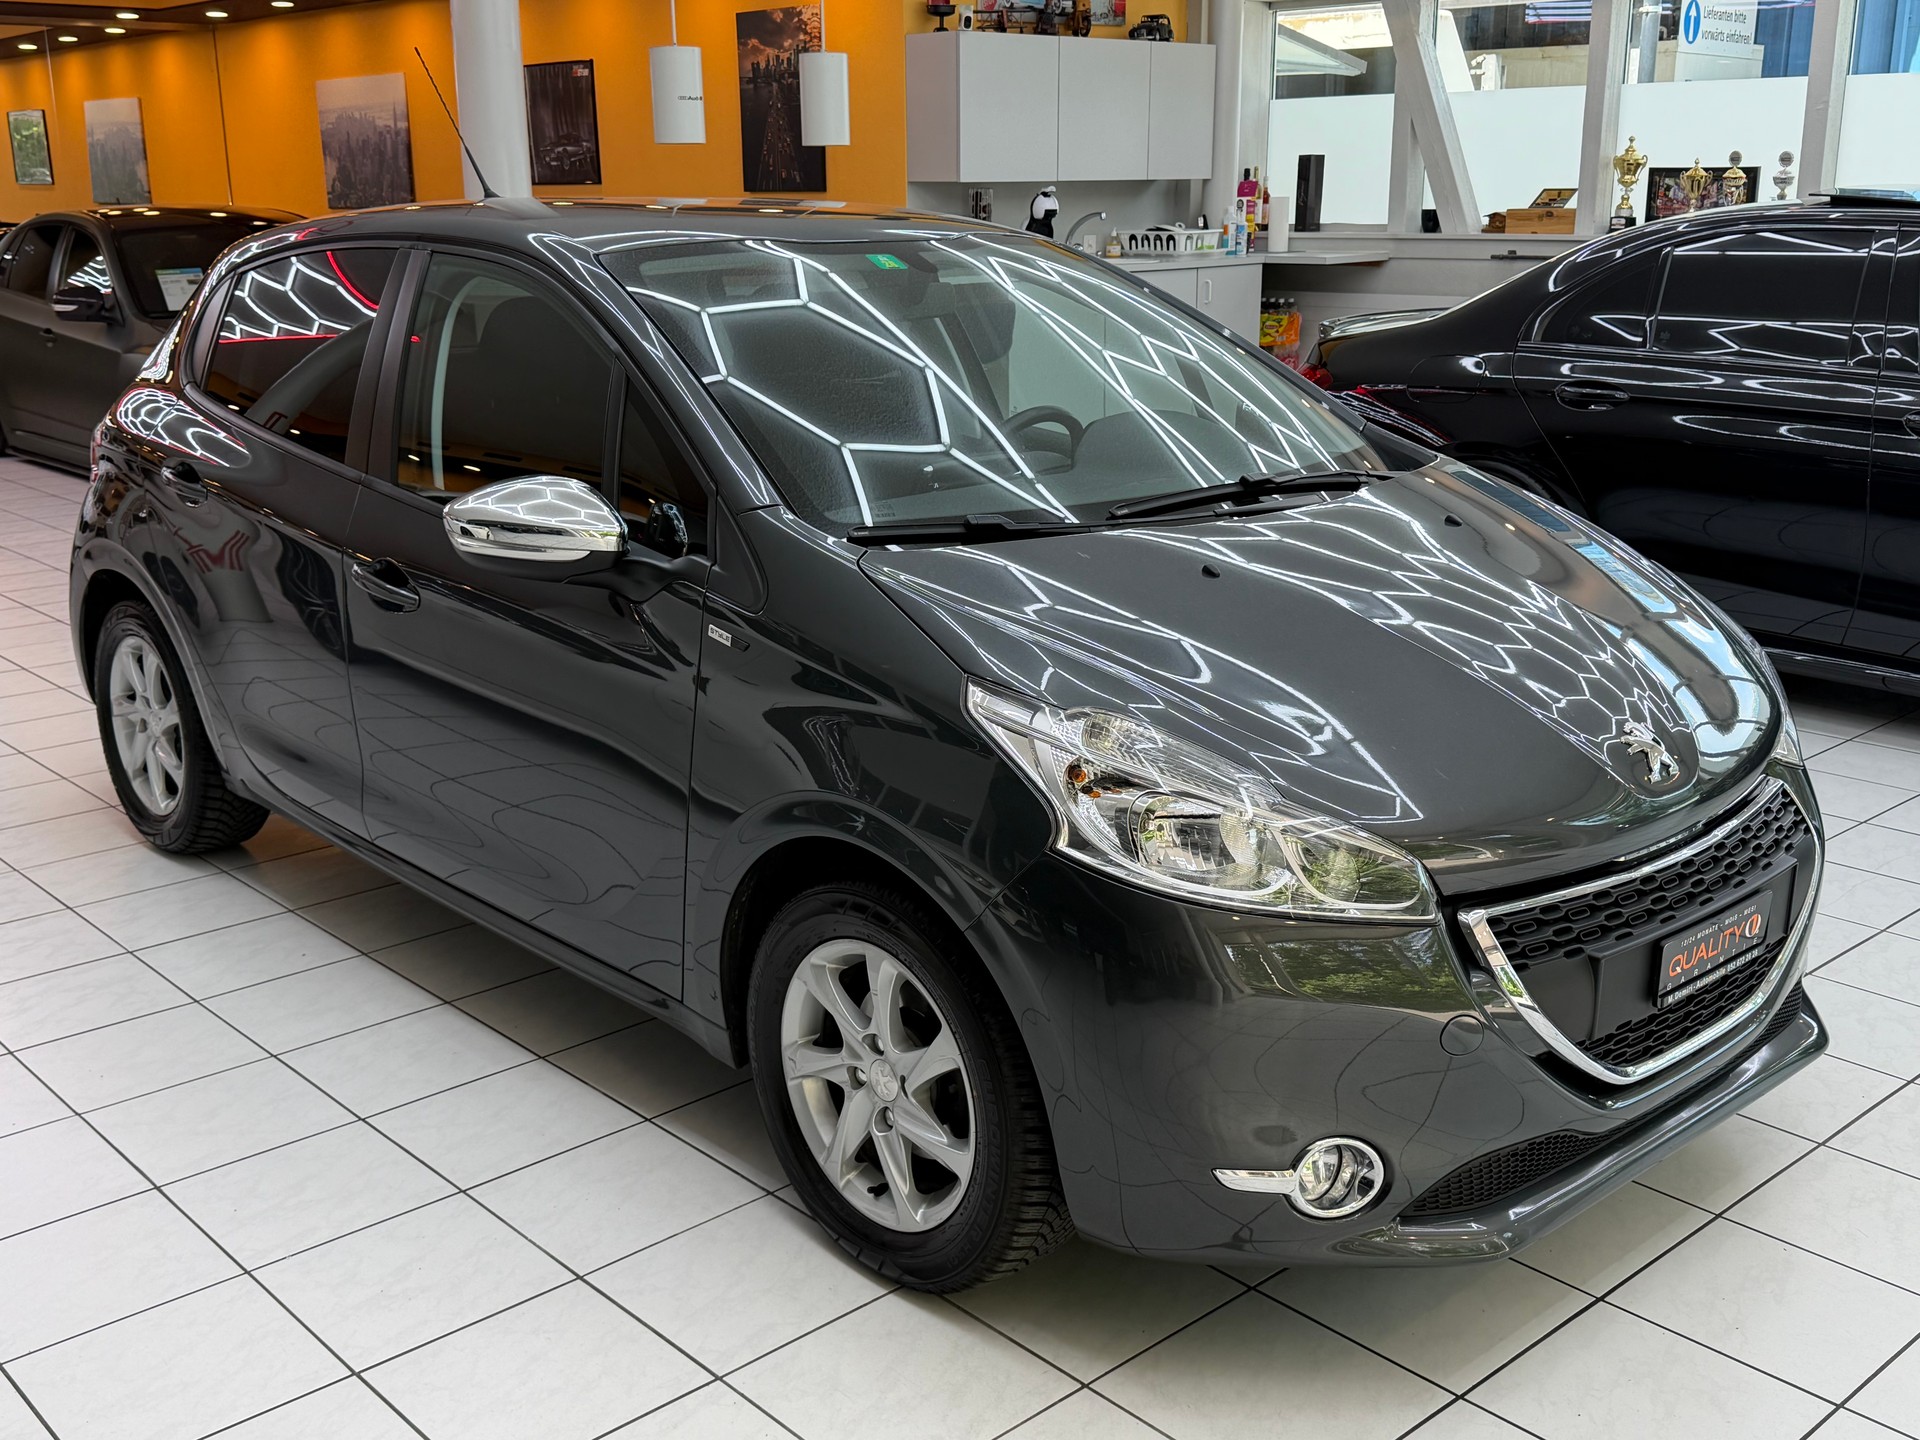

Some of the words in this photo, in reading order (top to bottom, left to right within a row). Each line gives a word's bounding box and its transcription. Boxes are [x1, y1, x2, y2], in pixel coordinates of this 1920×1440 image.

[1703, 5, 1733, 22] Lieferanten
[1734, 9, 1747, 24] bitte
[1701, 27, 1725, 42] vorwärts
[710, 627, 730, 642] STYLE
[1697, 924, 1719, 940] MONATE
[1669, 921, 1746, 977] QUALITY
